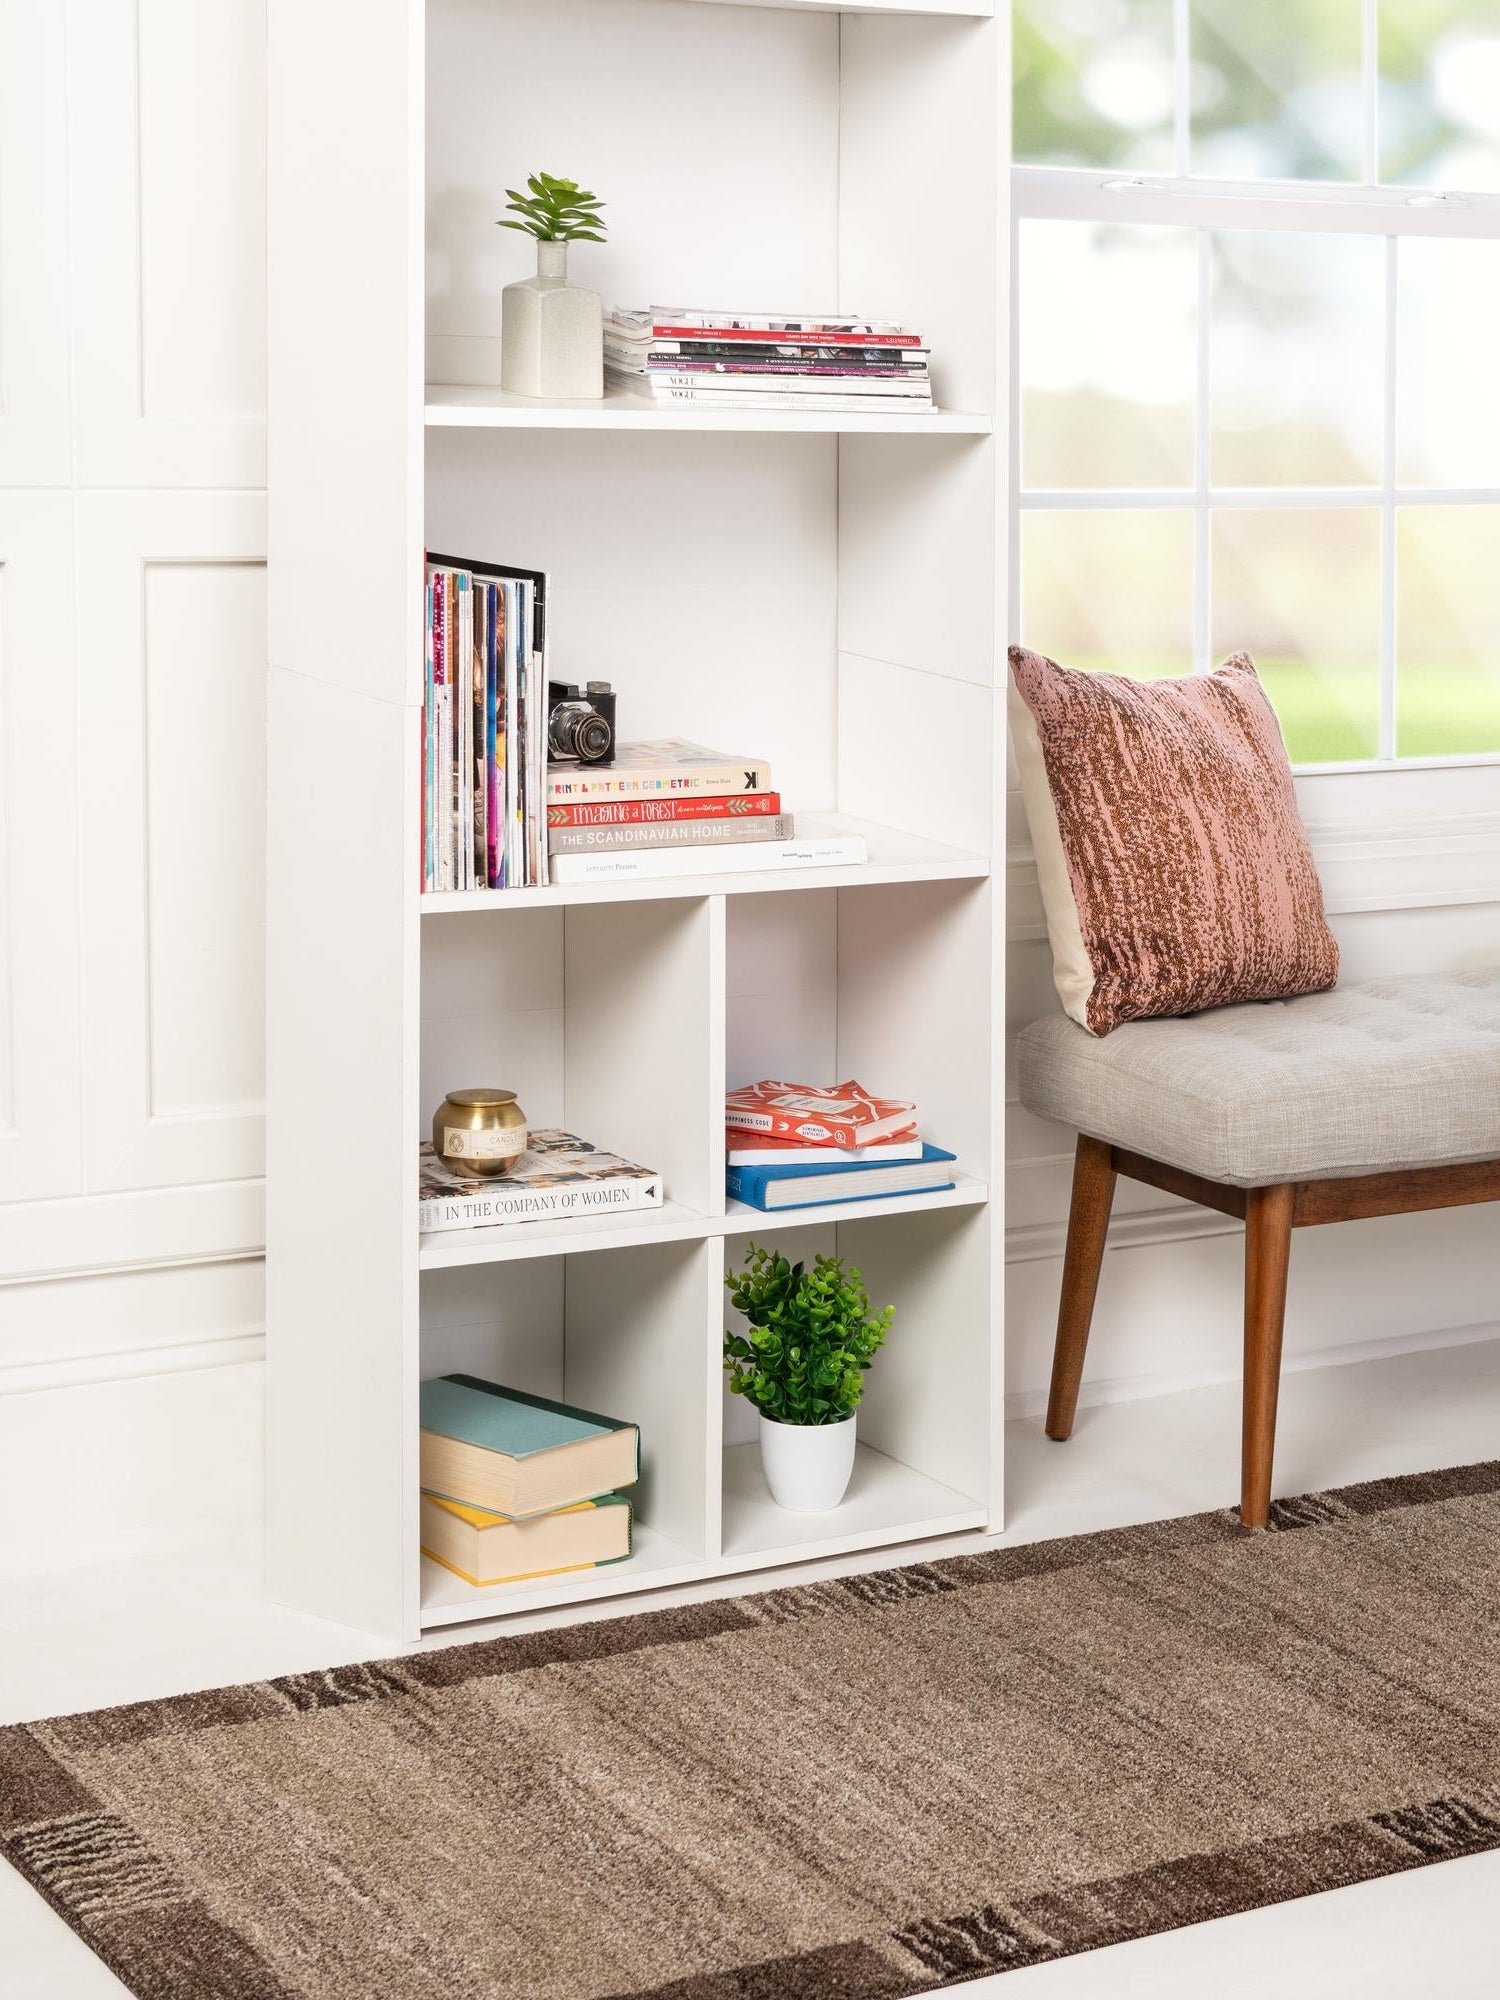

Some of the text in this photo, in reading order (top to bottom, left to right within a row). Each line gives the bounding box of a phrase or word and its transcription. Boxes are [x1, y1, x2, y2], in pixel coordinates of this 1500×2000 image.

[669, 377, 696, 386] VOGUE
[670, 390, 697, 399] VOGUE
[547, 784, 578, 794] PRINT
[591, 781, 639, 793] PATTERN
[642, 778, 700, 790] GEOMETRIC
[641, 801, 677, 821] FOREST
[561, 835, 583, 846] THE
[586, 826, 688, 844] SCANDINAVIAN
[692, 824, 731, 838] HOME
[755, 1119, 770, 1127] CODE
[445, 1187, 630, 1220] IN THE COMPANY OF WOMEN
